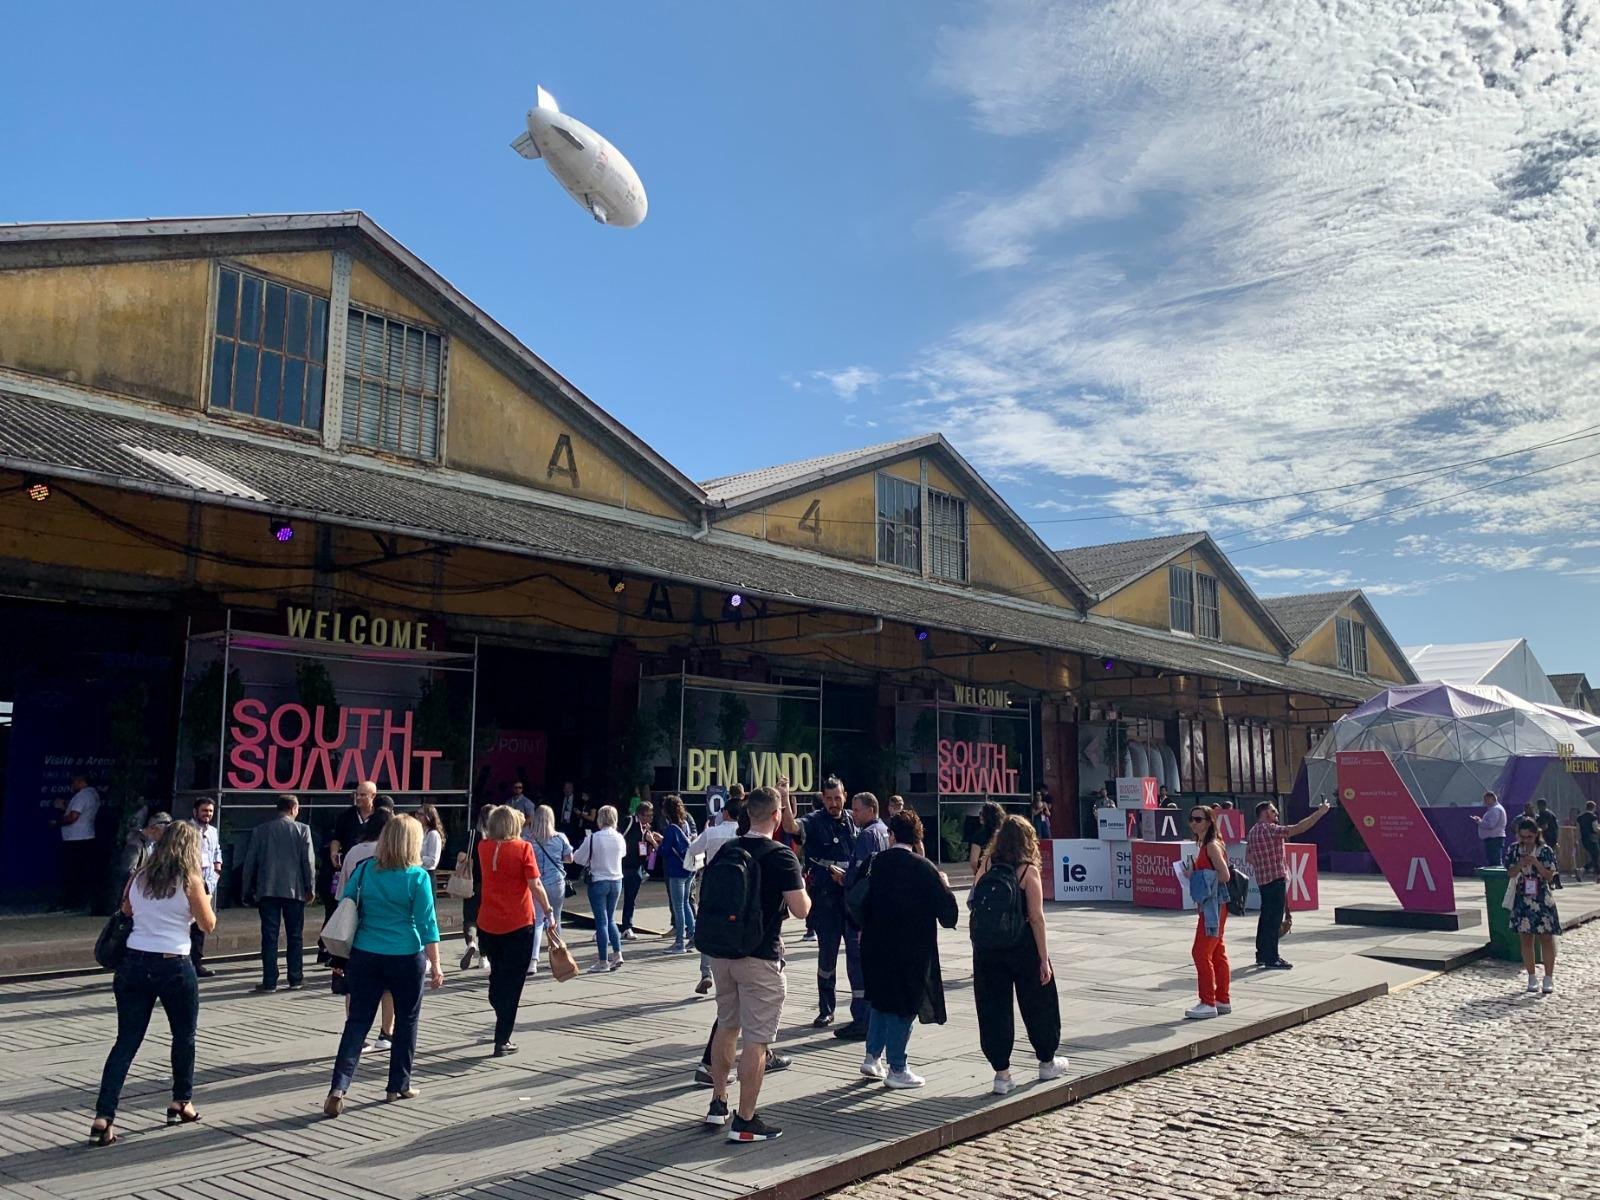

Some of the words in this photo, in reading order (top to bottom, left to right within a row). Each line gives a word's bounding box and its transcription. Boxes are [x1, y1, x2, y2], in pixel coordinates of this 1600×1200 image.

[547, 433, 581, 489] A
[798, 499, 822, 544] 4
[644, 583, 674, 621] A
[287, 606, 430, 651] WELCOME
[953, 684, 1011, 708] WELCOME
[229, 697, 414, 750] SOUTH
[938, 739, 1007, 769] SOUTH
[1556, 743, 1574, 758] VIP
[227, 744, 444, 791] SUMMIT
[687, 748, 738, 791] BEM
[750, 751, 813, 792] VINDO
[938, 766, 1018, 795] SUMMIT
[1566, 760, 1599, 774] MEETING
[1062, 856, 1087, 882] ie
[1136, 854, 1169, 866] SOUTH
[1136, 865, 1175, 877] SUMMIT
[1063, 885, 1104, 894] UNIVERSITY
[1154, 887, 1177, 895] ALEGRE
